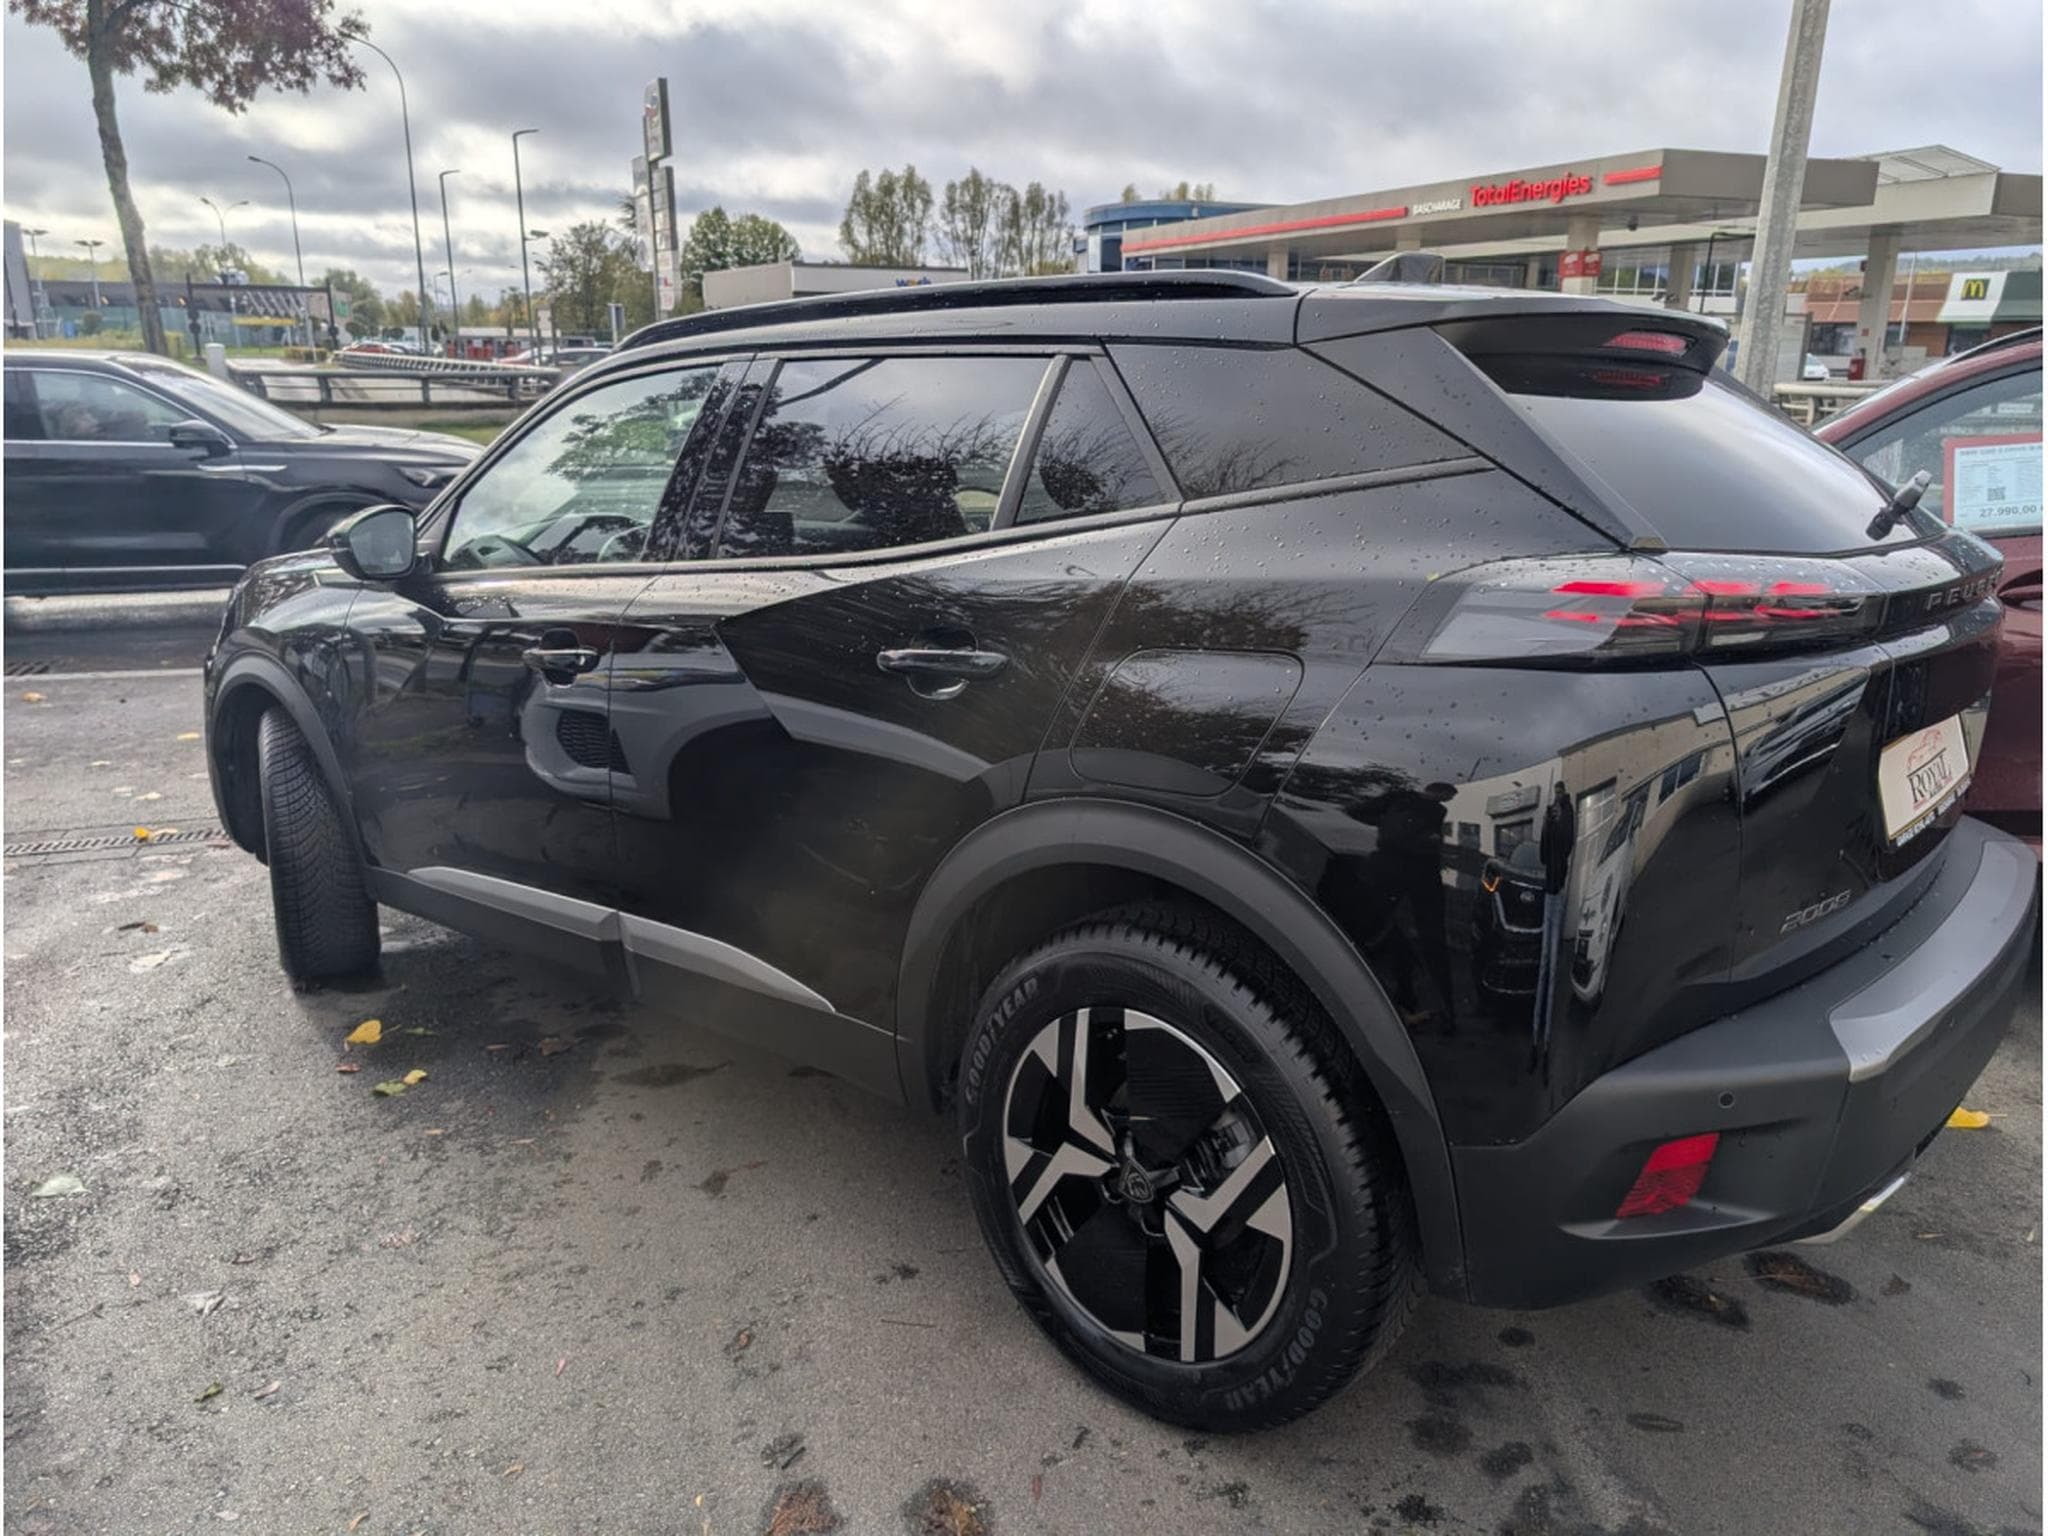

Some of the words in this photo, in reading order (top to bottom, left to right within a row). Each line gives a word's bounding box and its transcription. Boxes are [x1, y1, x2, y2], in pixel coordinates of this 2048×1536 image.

[1471, 173, 1593, 207] TotalEnergies
[1780, 888, 1852, 934] 2008
[964, 976, 1038, 1105] GOODYEAR
